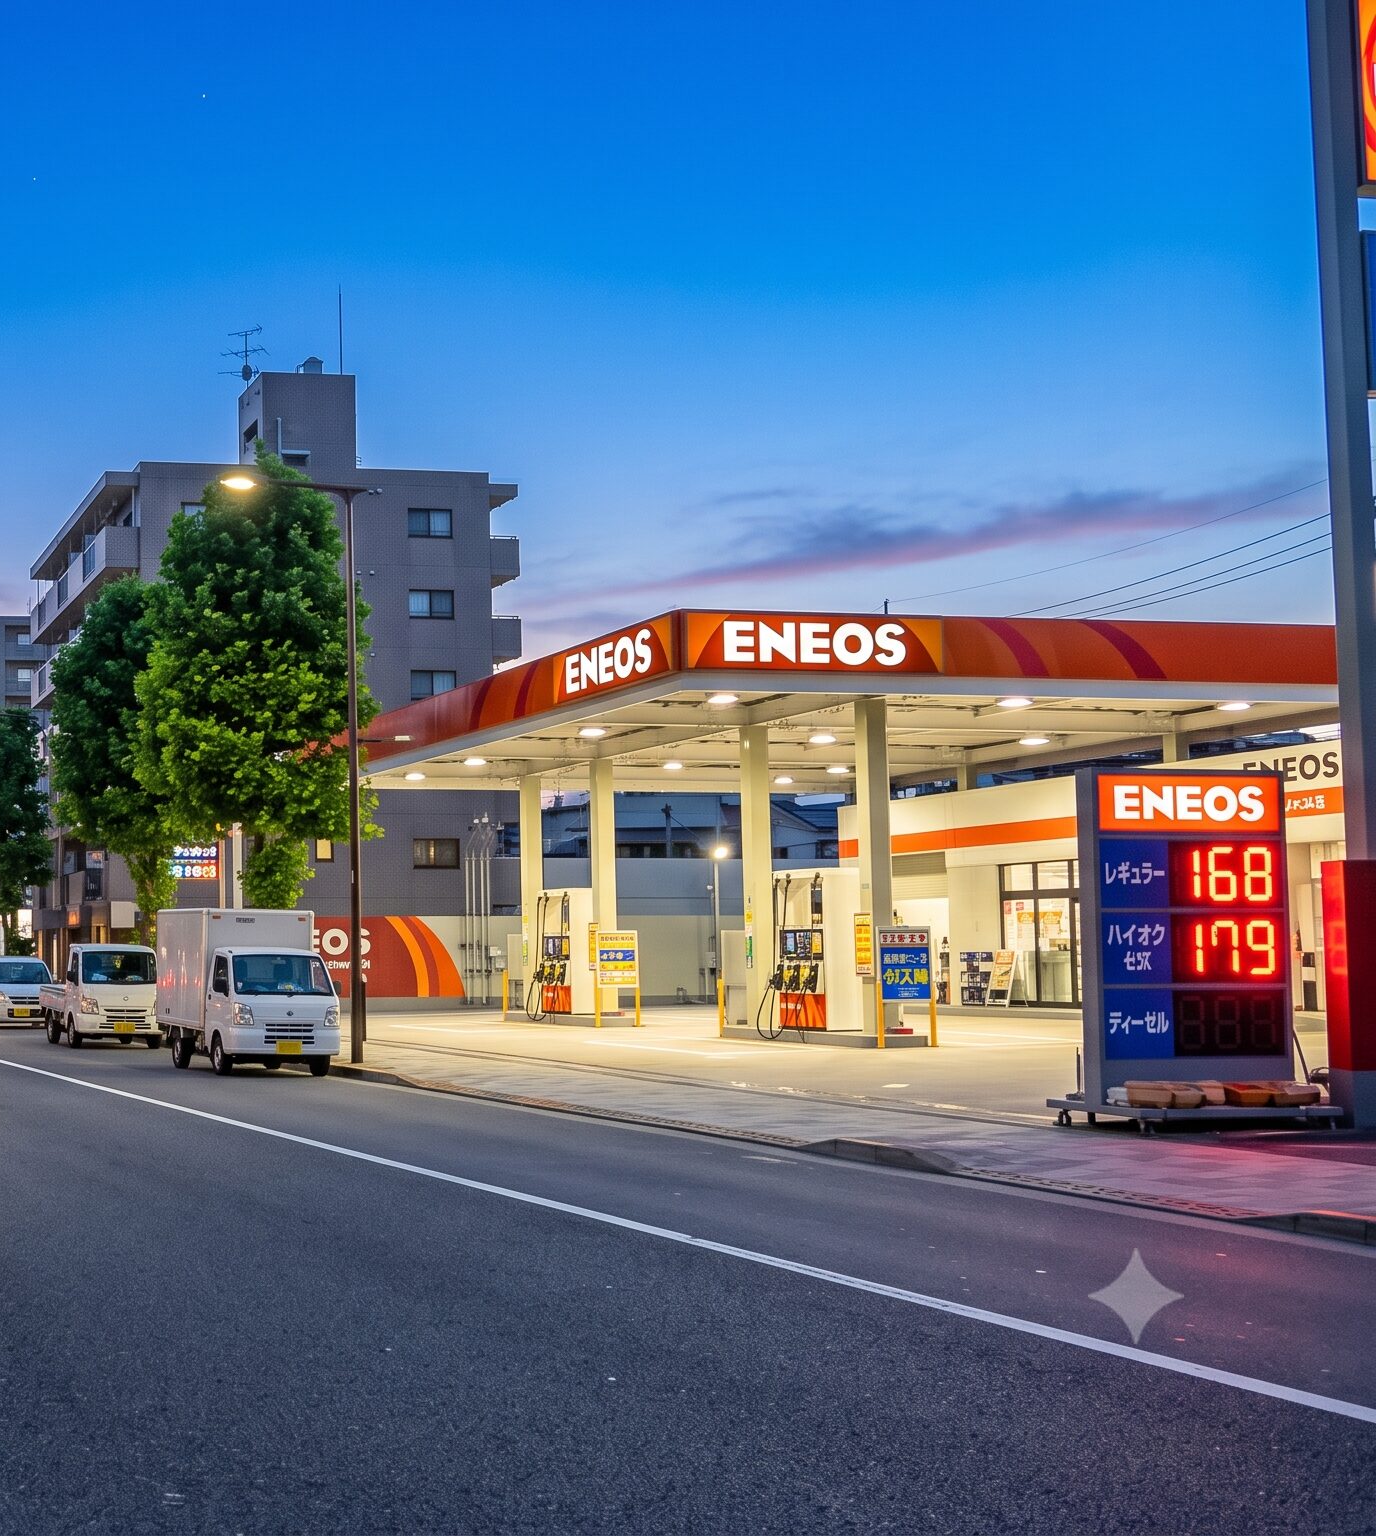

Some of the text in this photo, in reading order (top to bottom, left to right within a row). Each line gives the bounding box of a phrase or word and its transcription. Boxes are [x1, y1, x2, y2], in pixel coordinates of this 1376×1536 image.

[565, 628, 652, 695] ENEOS
[724, 620, 907, 667] ENEOS
[1113, 784, 1265, 822] ENEOS
[1105, 861, 1165, 885] レギュラー
[1193, 847, 1273, 901] 168
[1107, 923, 1165, 946] ハイオク
[1195, 920, 1276, 975] 179
